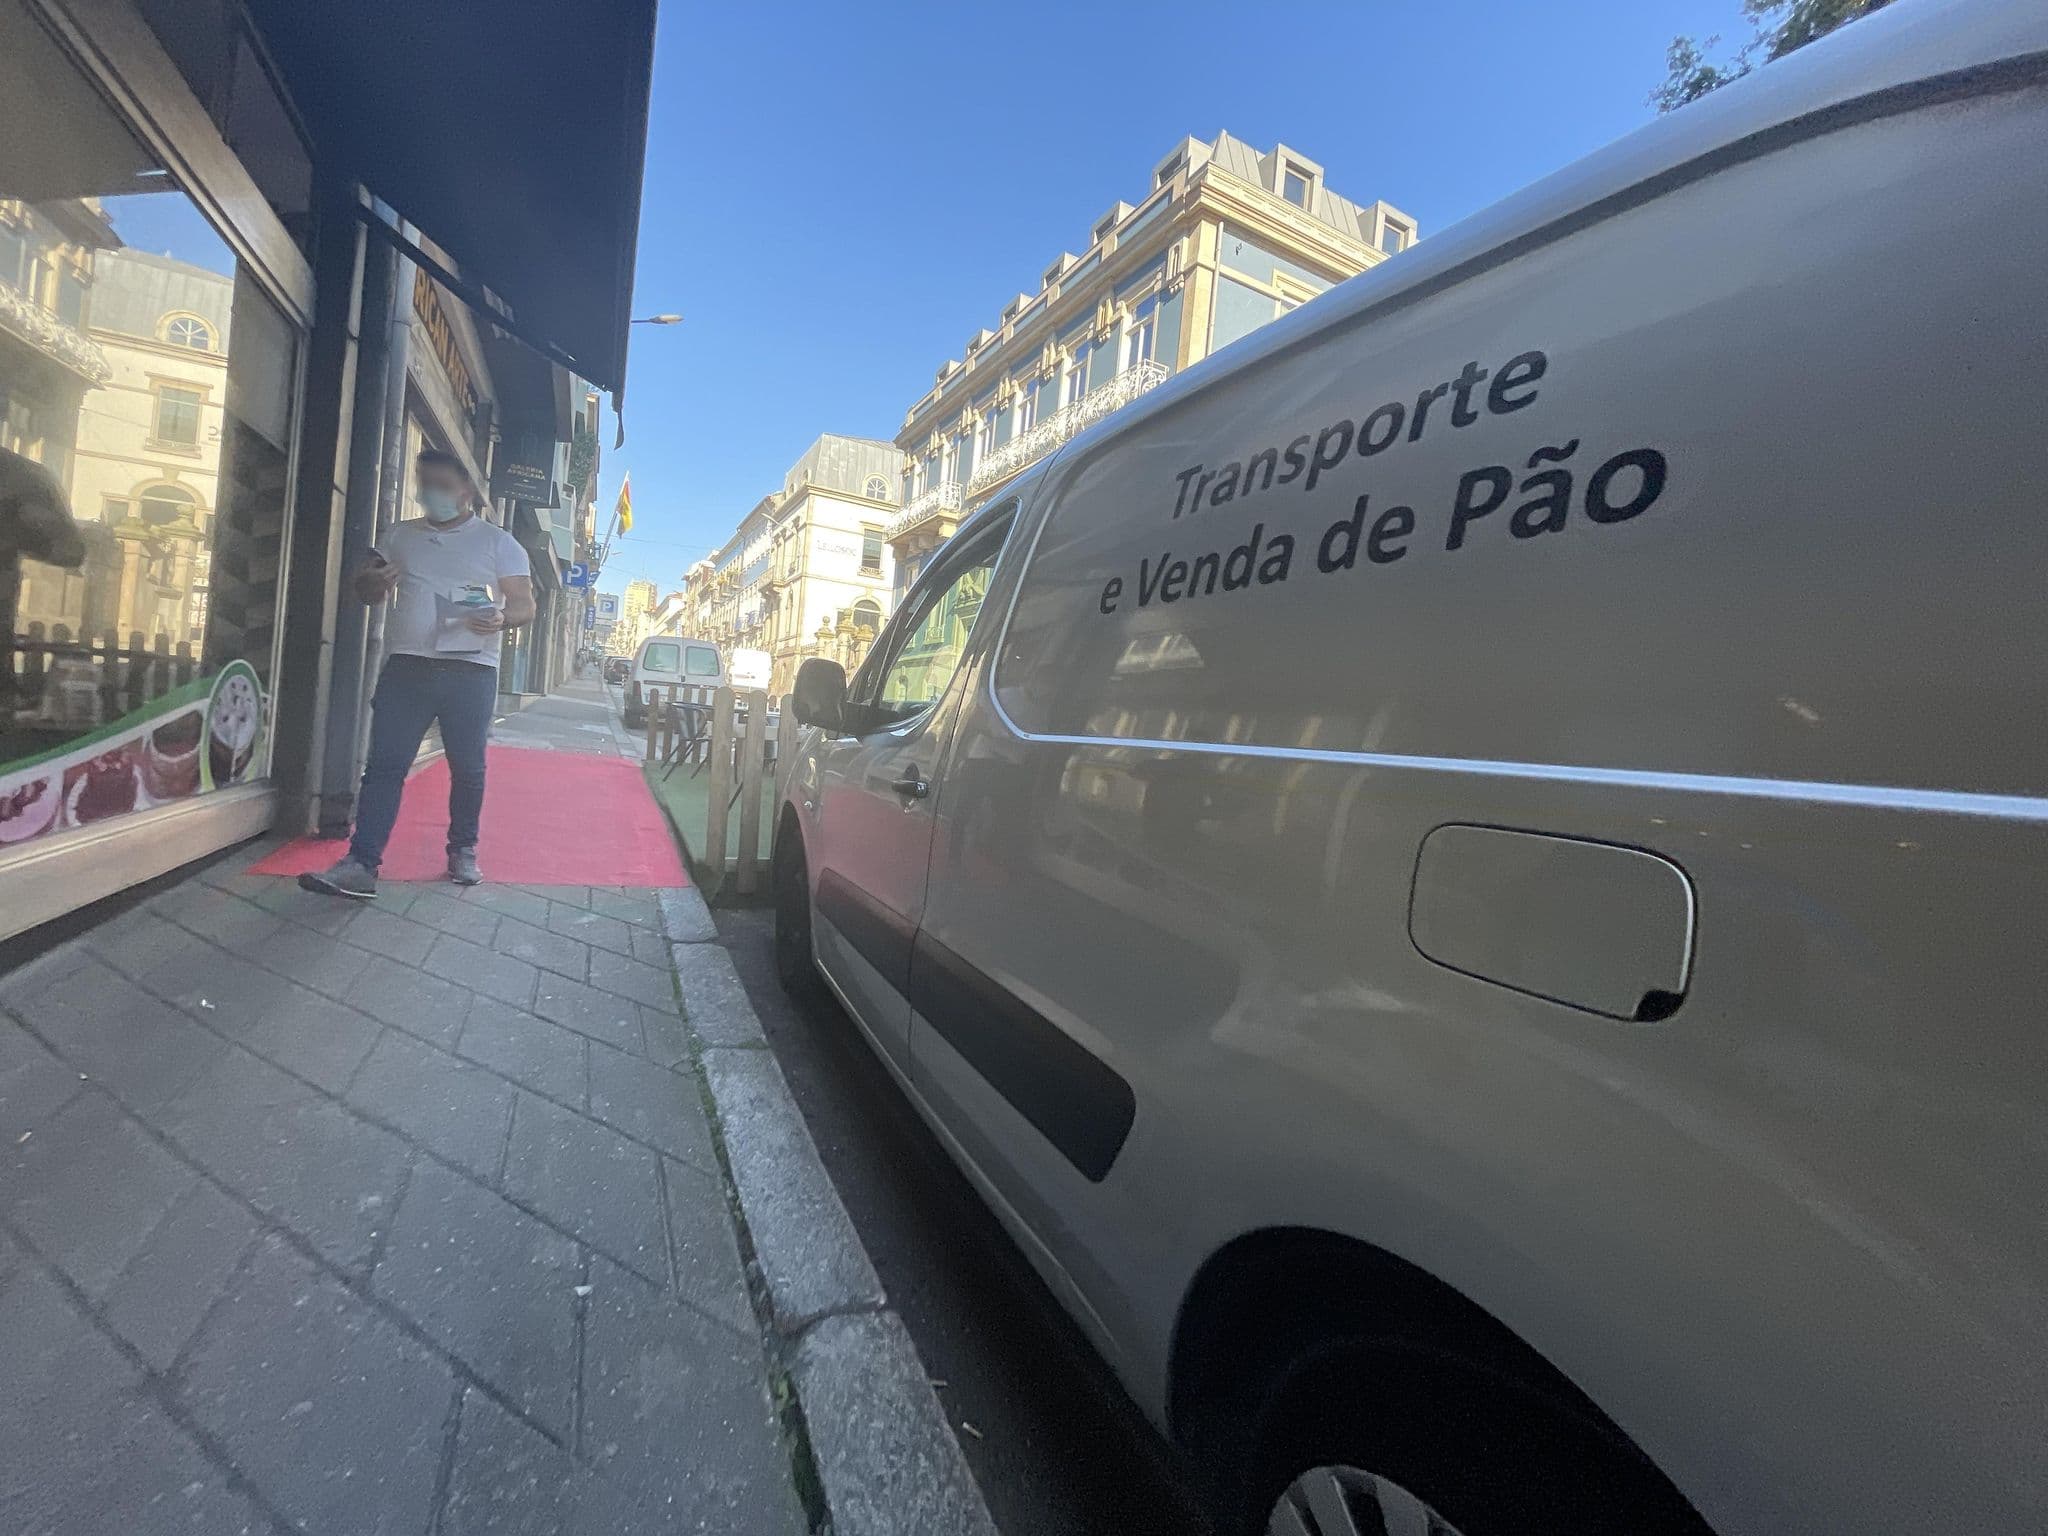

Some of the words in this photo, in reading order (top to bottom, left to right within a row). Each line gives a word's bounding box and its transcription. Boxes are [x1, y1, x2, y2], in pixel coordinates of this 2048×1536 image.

[1173, 350, 1547, 520] Transporte
[1099, 575, 1122, 615] e
[1137, 523, 1295, 607] Venda
[1317, 494, 1415, 574] de
[1445, 438, 1668, 551] Pão
[566, 565, 582, 584] P
[603, 601, 612, 612] P
